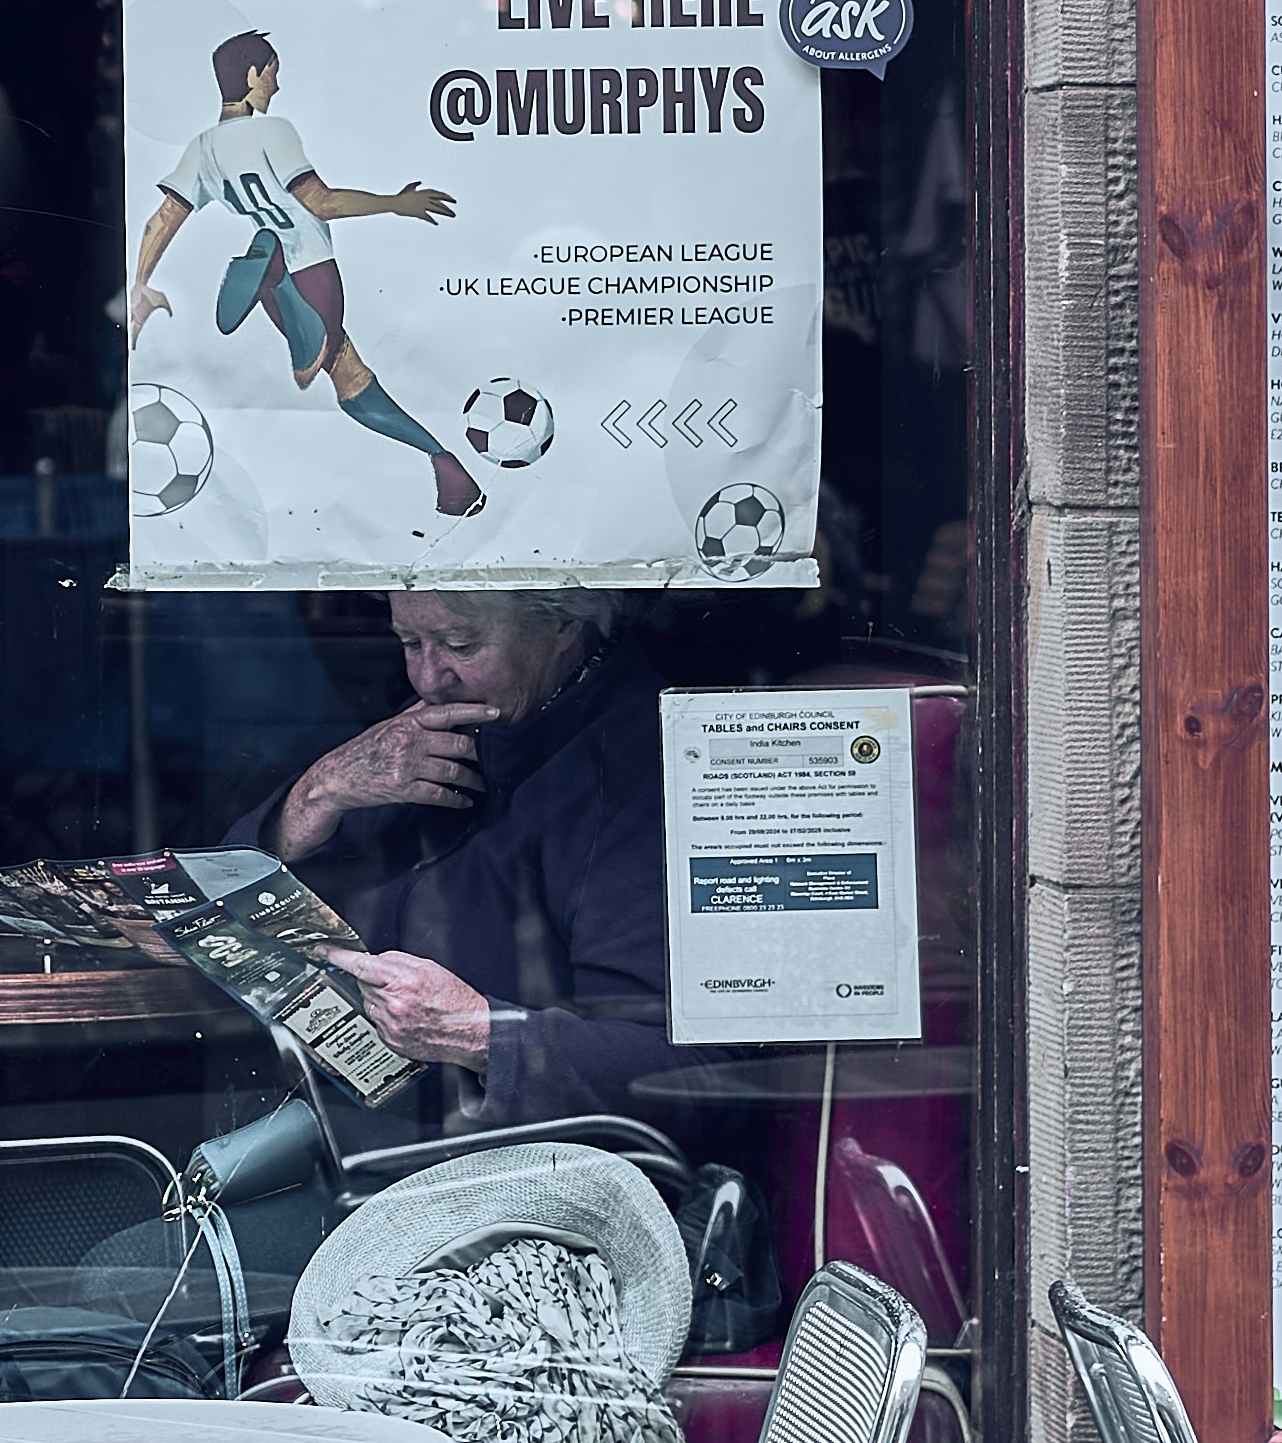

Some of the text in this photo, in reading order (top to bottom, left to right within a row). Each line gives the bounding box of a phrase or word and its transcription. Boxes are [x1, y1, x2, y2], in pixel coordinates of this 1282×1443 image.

[802, 43, 892, 61] ABOUT ALLERGENS
[429, 66, 766, 143] @MURPHYS
[680, 243, 773, 262] LEAGUE
[486, 277, 581, 296] LEAGUE
[588, 274, 774, 295] CHAMPIONSHIP
[681, 306, 774, 326] LEAGUE
[702, 724, 743, 732] TABLES
[766, 723, 806, 731] CHAIRS
[809, 722, 860, 730] CONSENT
[710, 895, 763, 903] CLARENCE
